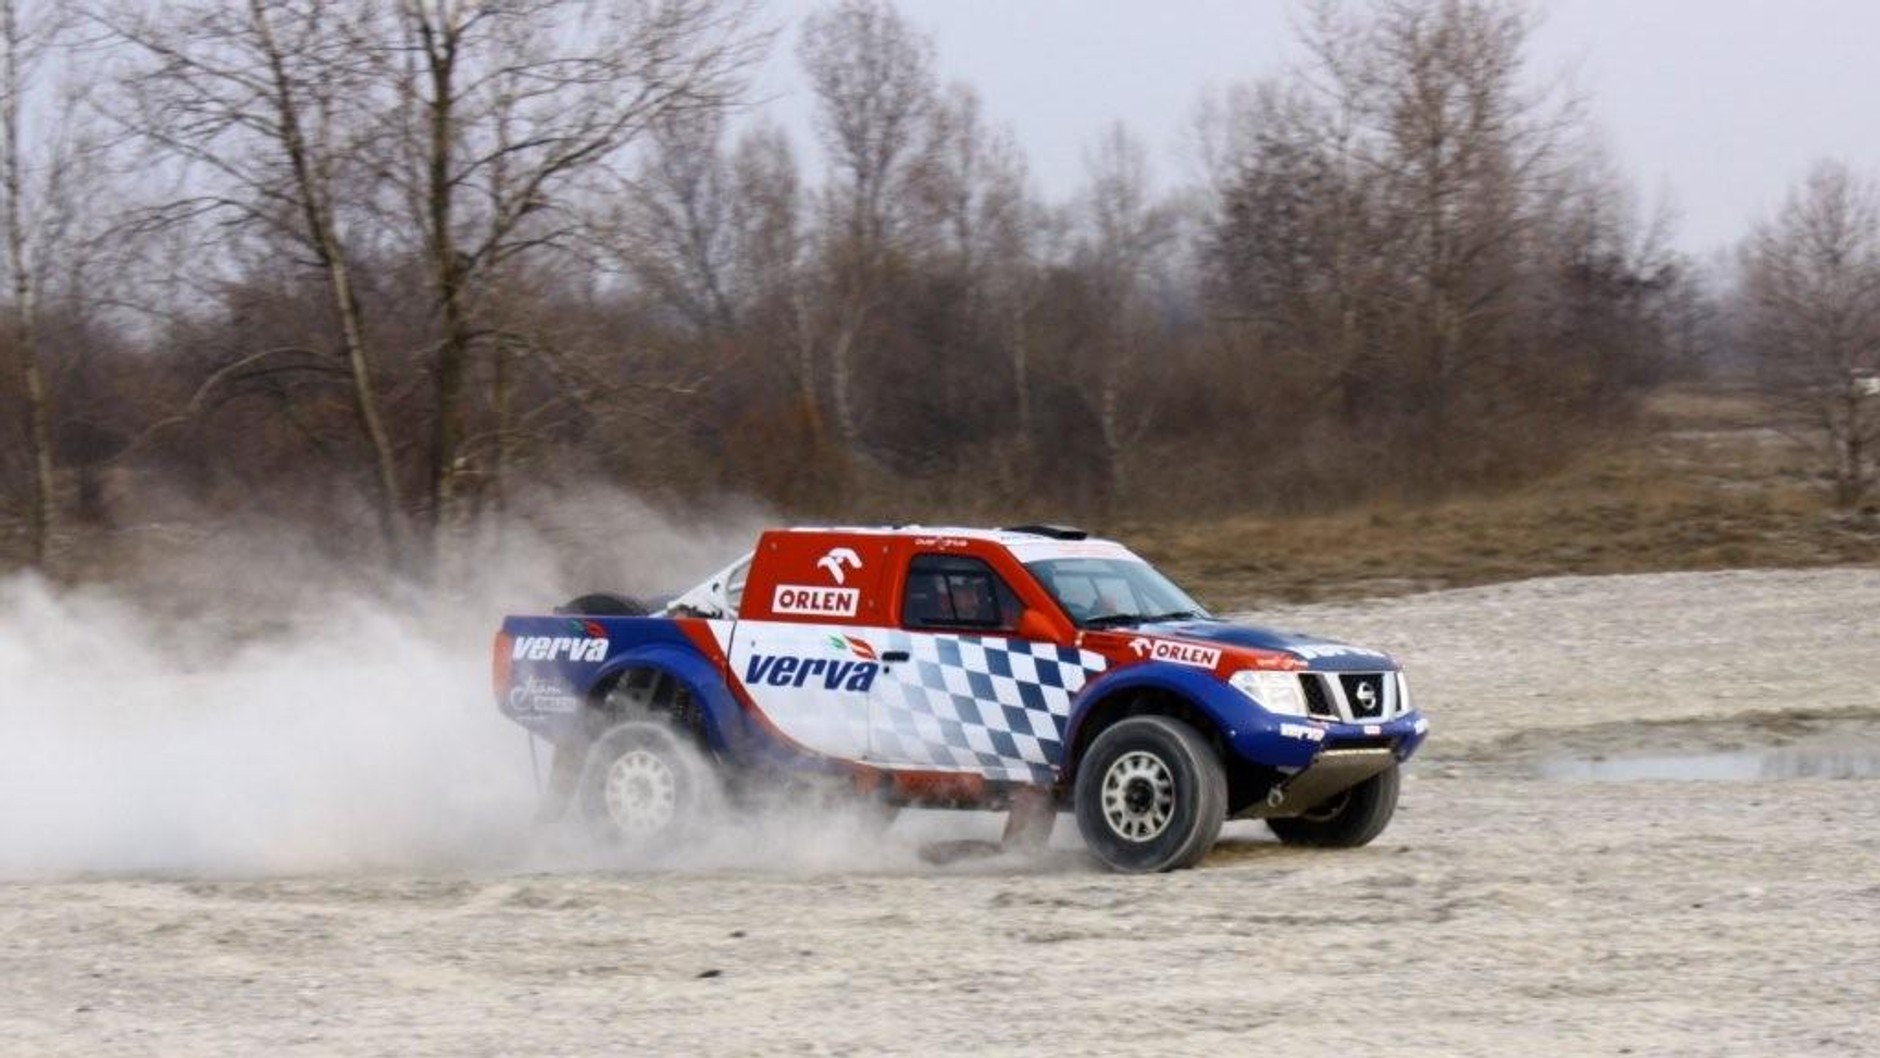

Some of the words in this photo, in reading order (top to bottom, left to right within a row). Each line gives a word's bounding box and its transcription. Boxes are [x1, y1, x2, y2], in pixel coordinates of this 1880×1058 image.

[778, 589, 853, 612] ORLEN
[512, 636, 610, 662] verva
[1156, 644, 1215, 665] ORLEN
[745, 654, 879, 692] verva
